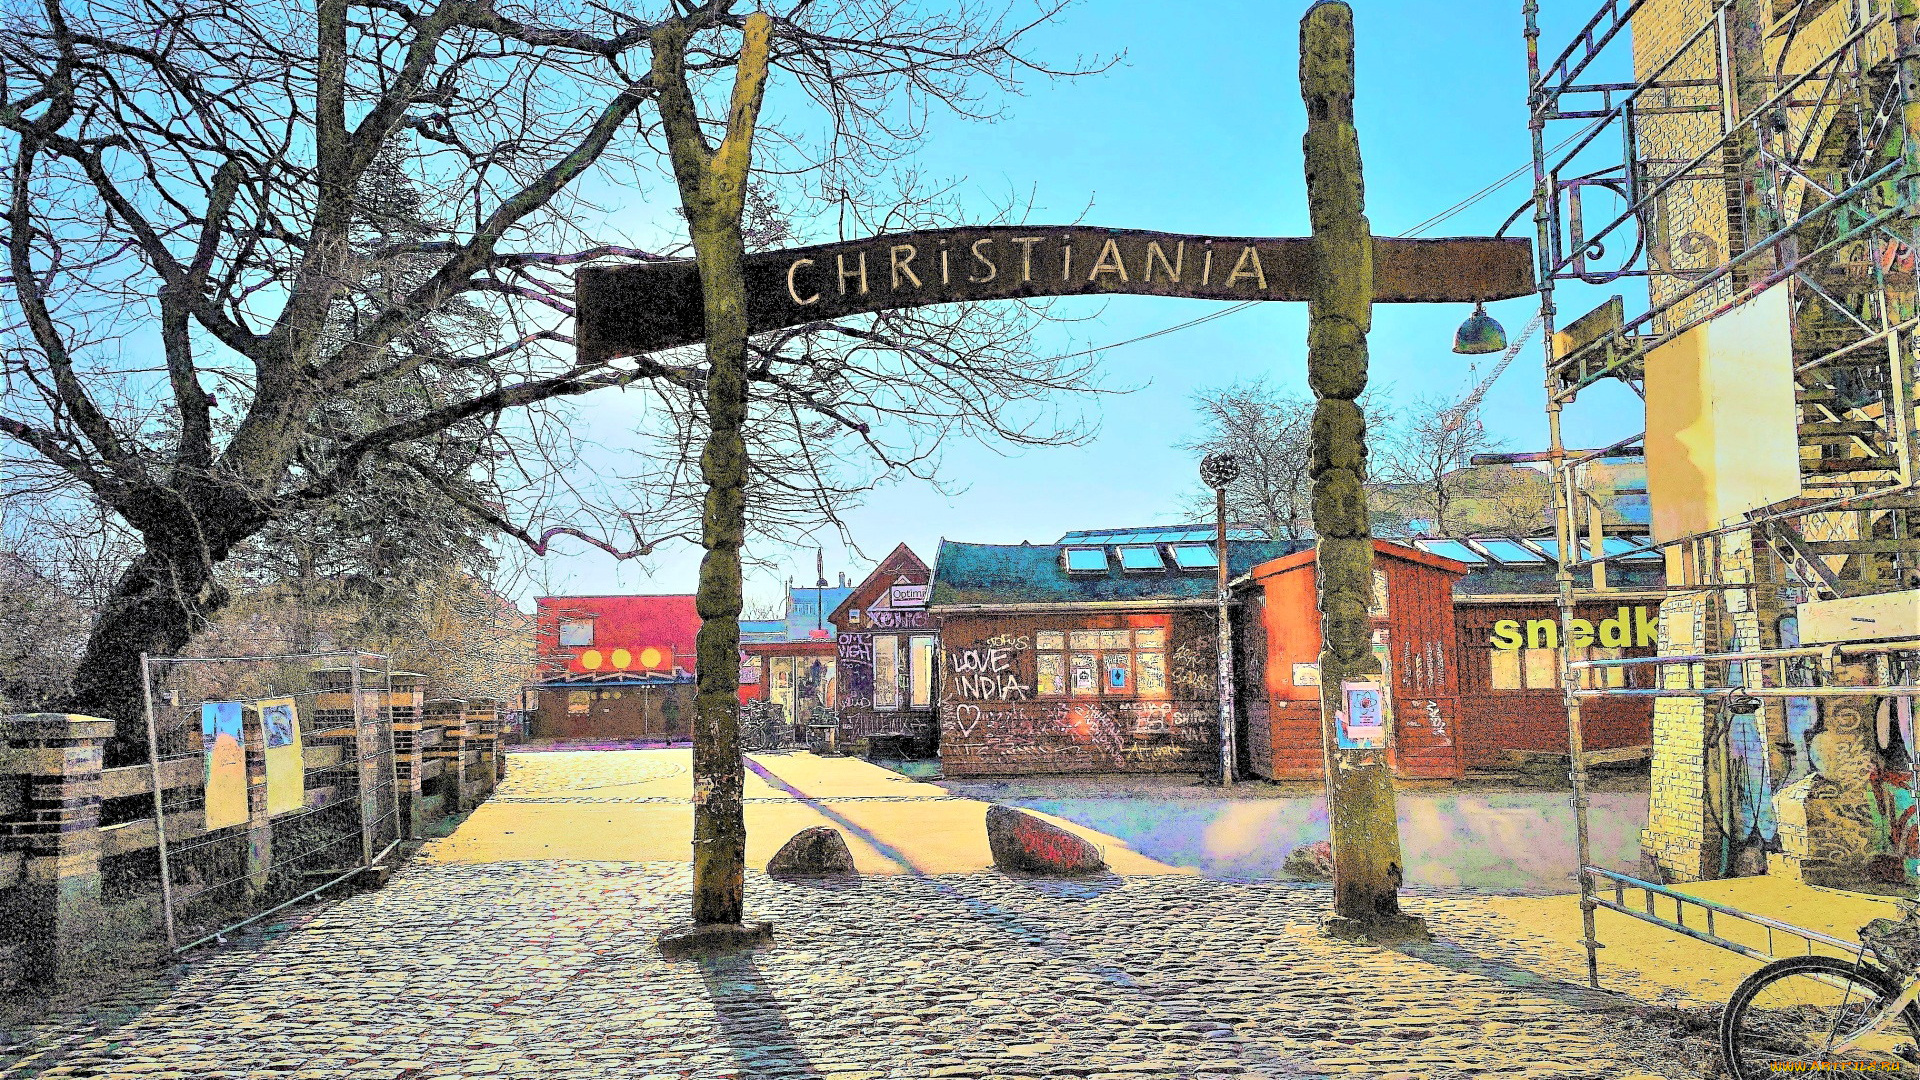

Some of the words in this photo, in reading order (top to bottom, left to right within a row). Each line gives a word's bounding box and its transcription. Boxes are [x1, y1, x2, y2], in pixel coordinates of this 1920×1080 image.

[1490, 606, 1659, 650] snedk
[952, 647, 1012, 673] LOVE
[955, 673, 1029, 701] INDIA
